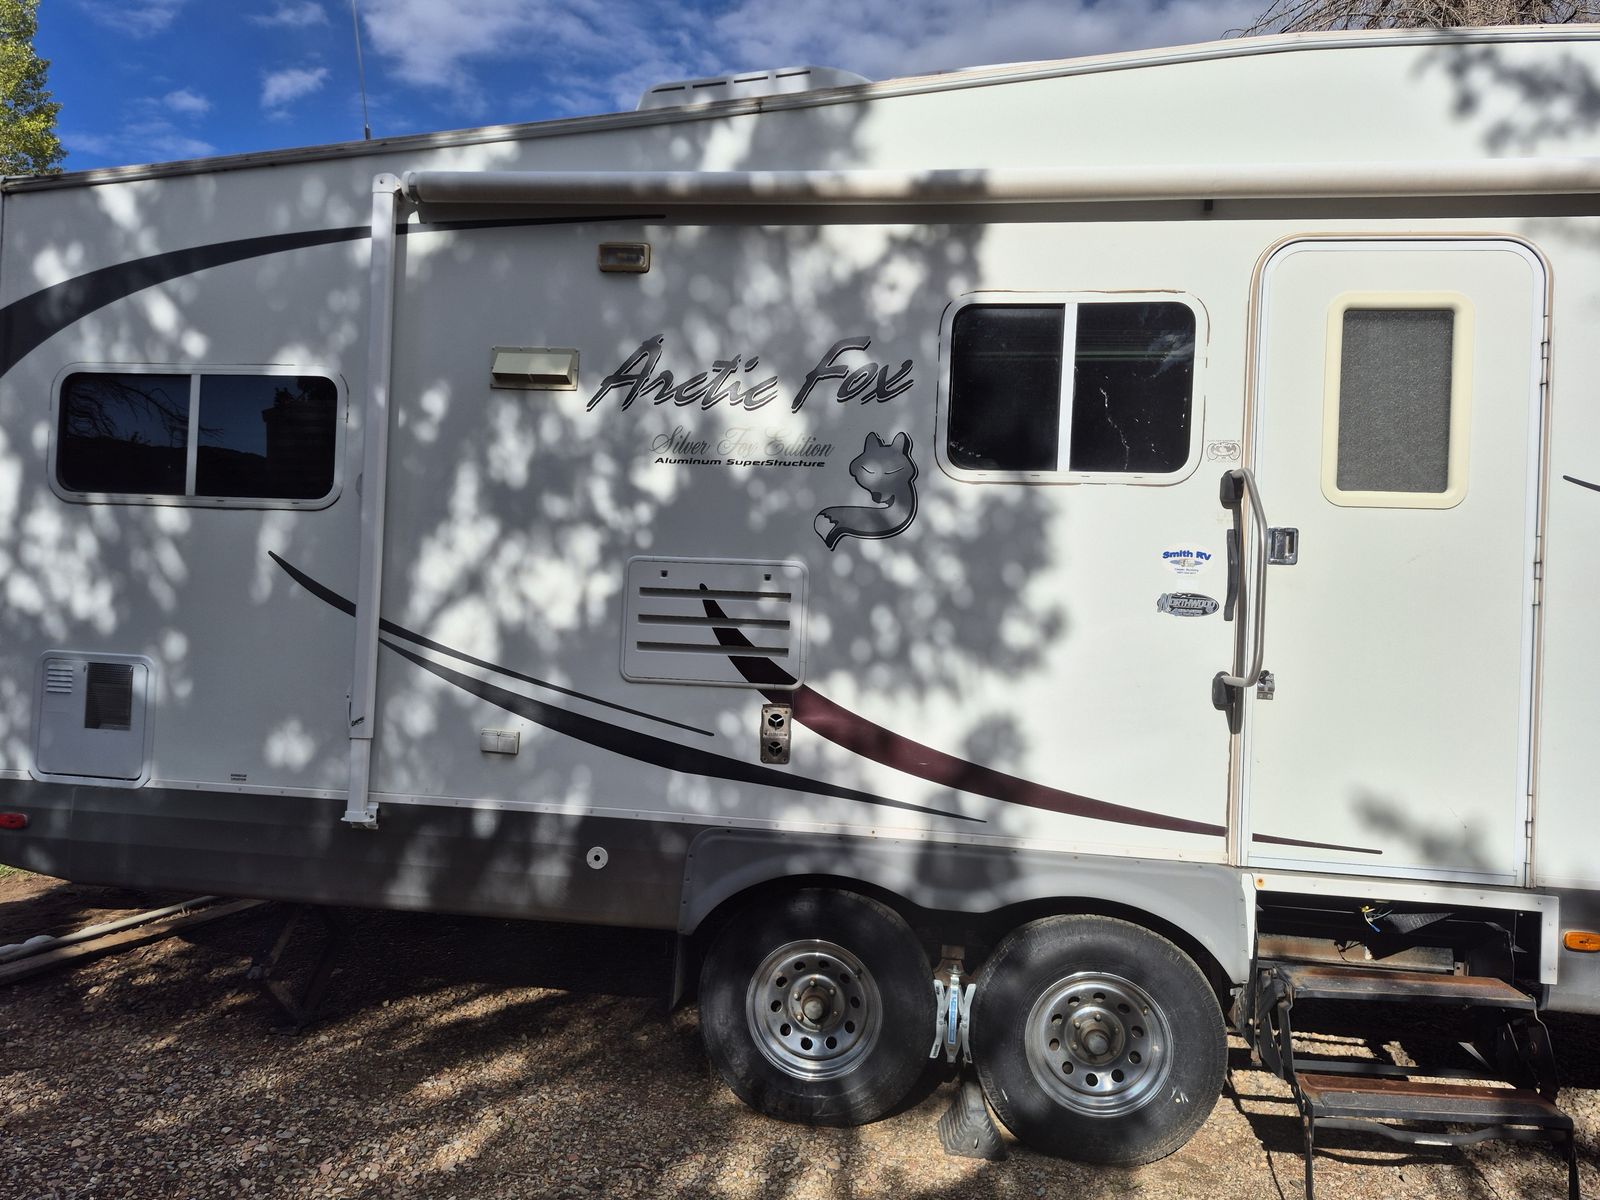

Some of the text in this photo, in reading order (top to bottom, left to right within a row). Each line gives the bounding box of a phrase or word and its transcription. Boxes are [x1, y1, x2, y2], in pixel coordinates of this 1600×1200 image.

[586, 333, 914, 413] Arctic Fox
[649, 425, 834, 458] Silver Fox Edition
[654, 457, 826, 467] Aluminum SuperStructure
[1162, 550, 1211, 561] Smith RV
